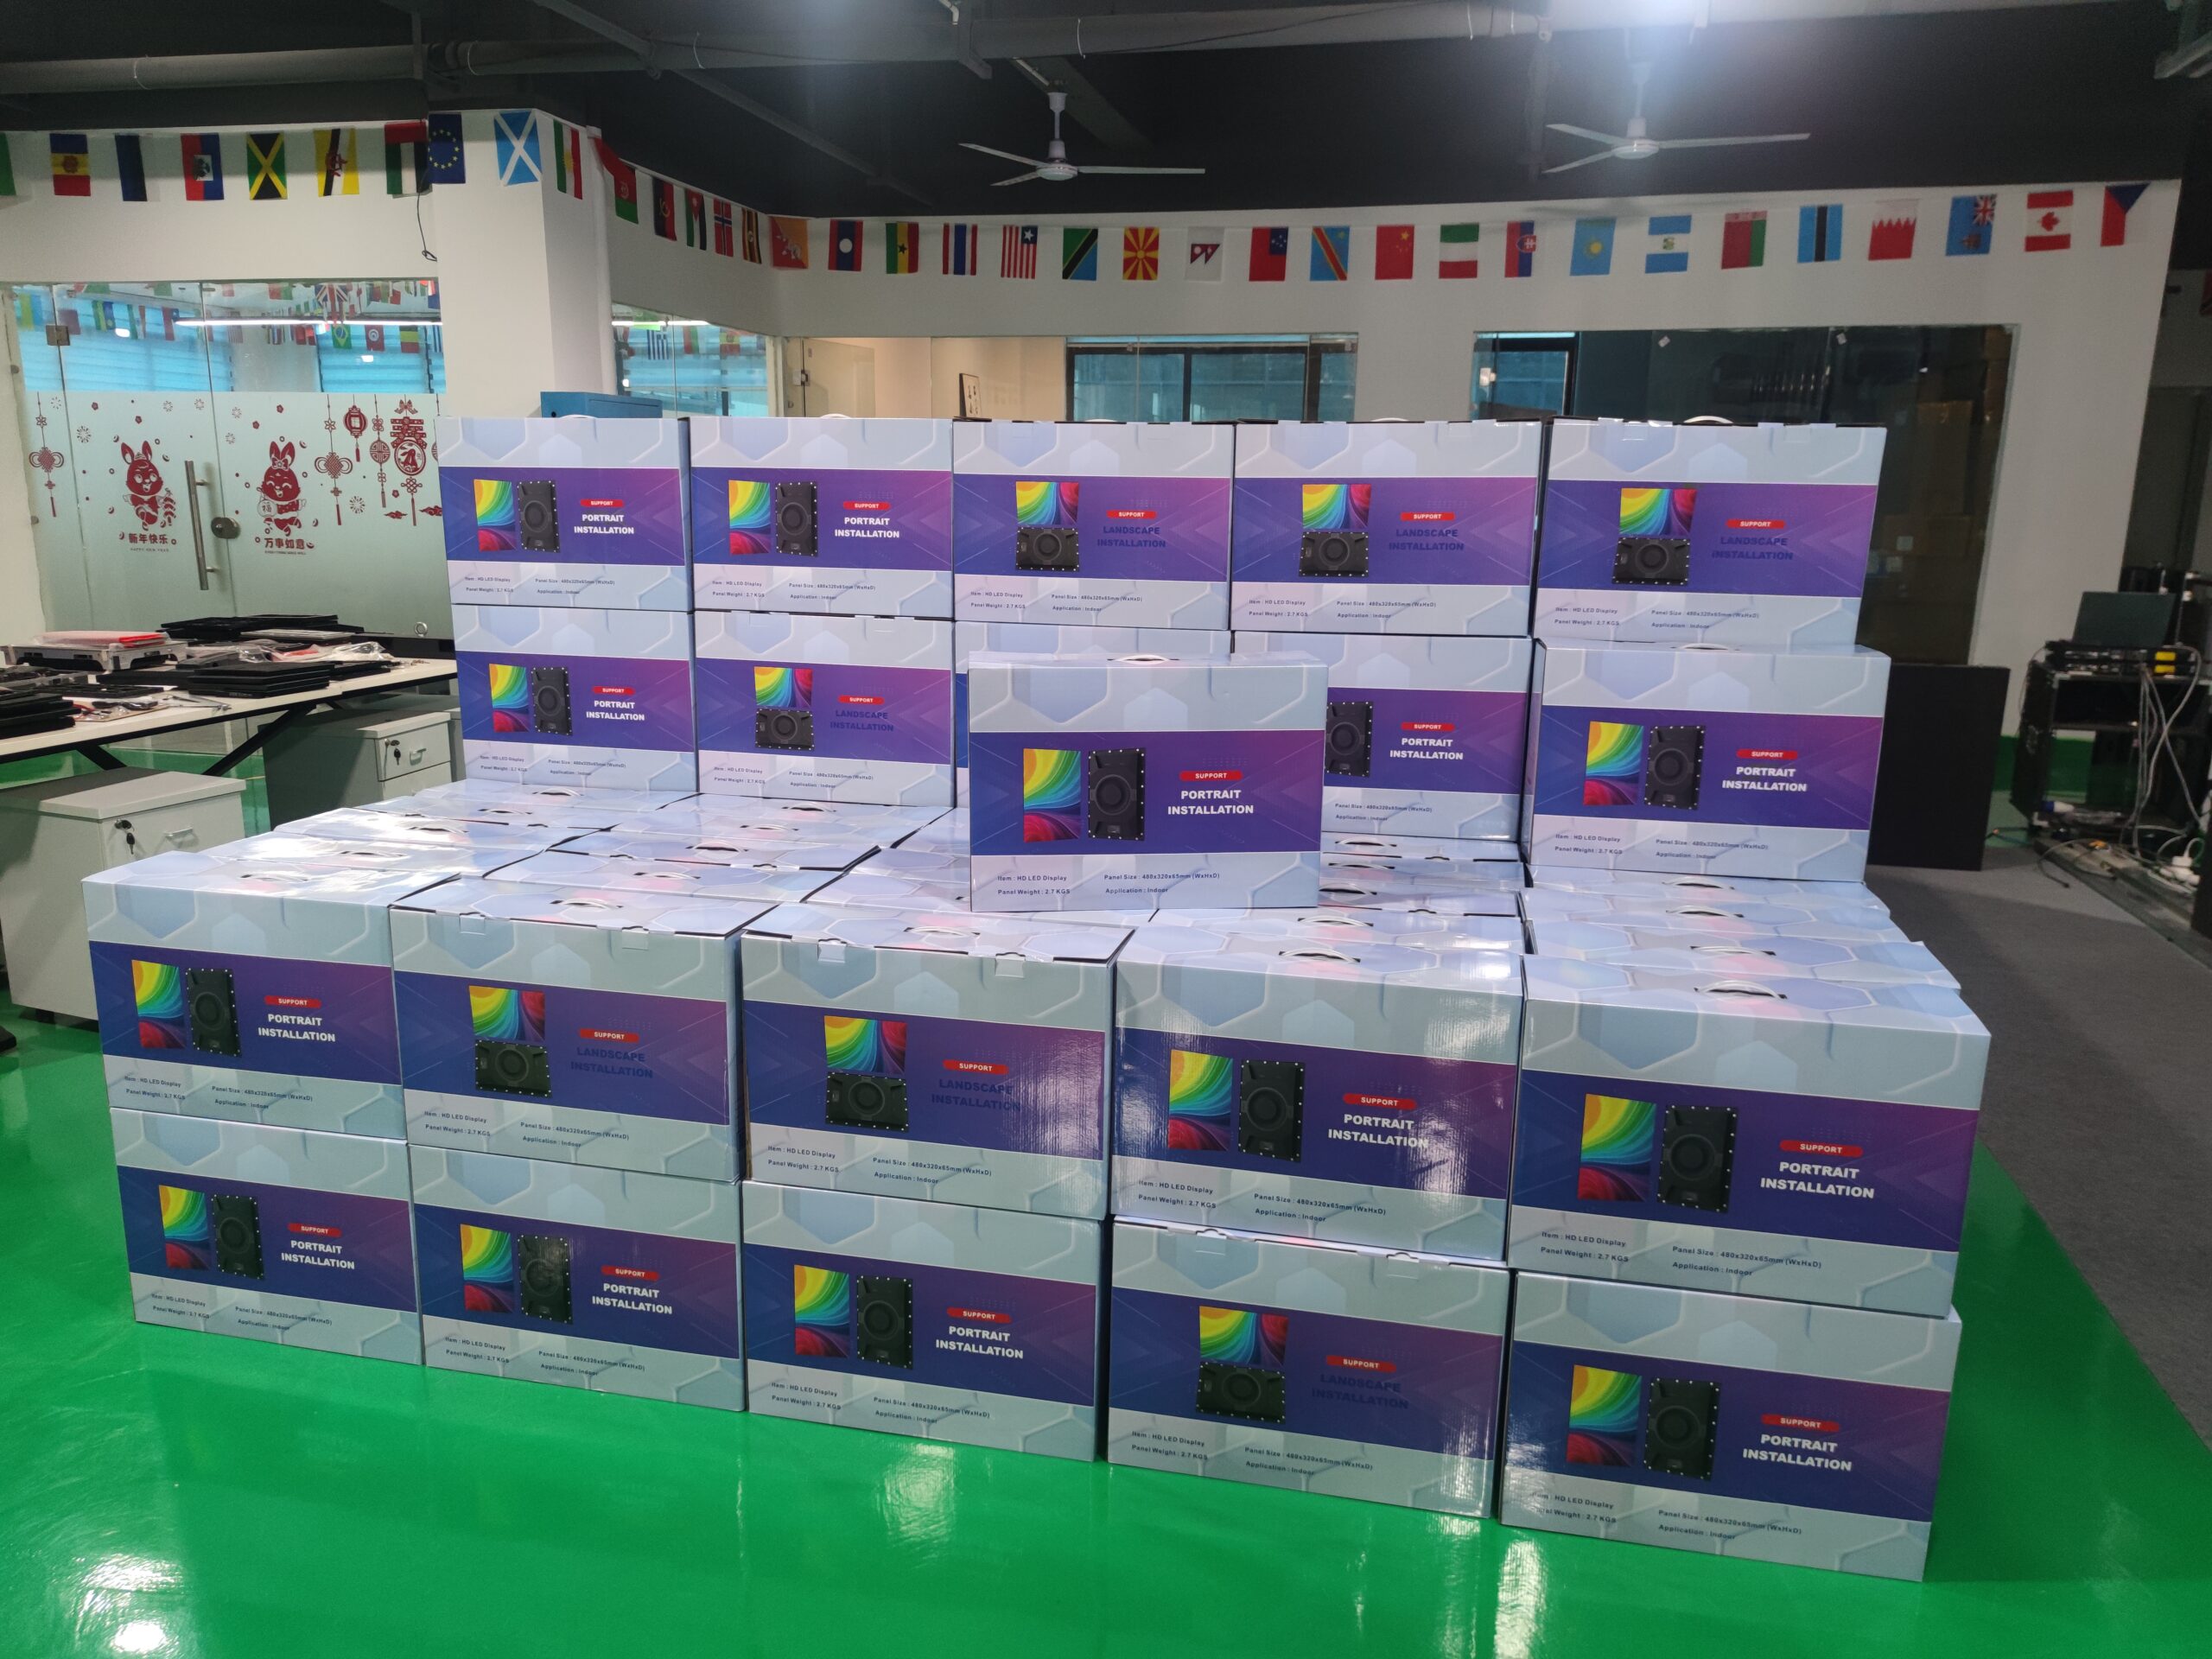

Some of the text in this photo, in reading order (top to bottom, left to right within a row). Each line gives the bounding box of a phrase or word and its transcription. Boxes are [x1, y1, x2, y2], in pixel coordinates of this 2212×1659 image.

[844, 517, 890, 525] PORTRAIT
[574, 525, 634, 534] INSTALLATION
[835, 529, 899, 538] INSTALLATION
[1103, 525, 1160, 535] LANDSCAPE
[1395, 529, 1459, 537] LANDSCAPE
[129, 533, 168, 544] 新年快乐
[1096, 538, 1166, 548] INSTALLATION
[1719, 536, 1788, 546] LANDSCAPE
[1711, 550, 1793, 561] INSTALLATION
[594, 700, 635, 709] PORTRAIT
[586, 711, 645, 721] INSTALLATION
[835, 709, 888, 720] LANDSCAPE
[830, 721, 893, 732] INSTALLATION
[1401, 737, 1452, 747] PORTRAIT
[1389, 750, 1463, 760] INSTALLATION
[1735, 766, 1796, 777] PORTRAIT
[1721, 779, 1808, 791] INSTALLATION
[1180, 789, 1242, 799] PORTRAIT
[1167, 804, 1254, 815] INSTALLATION
[277, 997, 307, 1006] SUPPORT
[268, 1013, 322, 1027] PORTRAIT
[257, 1027, 335, 1042] INSTALLATION
[593, 1031, 625, 1040] SUPPORT
[575, 1046, 646, 1063] LANDSCAPE
[569, 1061, 653, 1078] INSTALLATION
[958, 1062, 993, 1071] SUPPORT
[938, 1077, 1014, 1095] LANDSCAPE
[931, 1093, 1021, 1112] INSTALLATION
[1360, 1096, 1398, 1106] SUPPORT
[1343, 1113, 1414, 1130] PORTRAIT
[1327, 1128, 1428, 1149] INSTALLATION
[1799, 1143, 1842, 1154] SUPPORT
[811, 1150, 836, 1159] Display
[787, 1161, 810, 1170] Weight
[1778, 1161, 1859, 1179] PORTRAIT
[874, 1171, 912, 1181] Application
[1186, 1185, 1213, 1195] Display
[1760, 1177, 1875, 1198] INSTALLATION
[1138, 1193, 1158, 1202] Panel
[1159, 1196, 1184, 1206] Weight
[1254, 1192, 1274, 1201] Panel
[1353, 1205, 1386, 1215] (WxHxD)
[1255, 1208, 1325, 1222] Application Indoor
[300, 1225, 328, 1234] SUPPORT
[290, 1239, 342, 1255] PORTRAIT
[1596, 1237, 1626, 1248] Display
[1540, 1246, 1562, 1255] Panel
[1563, 1249, 1592, 1259] Weight
[1611, 1254, 1629, 1262] KGS
[1672, 1245, 1695, 1254] Panel
[1697, 1248, 1714, 1256] Size
[1784, 1257, 1822, 1268] (WxHxD)
[281, 1252, 355, 1270] INSTALLATION
[614, 1268, 645, 1277] SUPPORT
[1672, 1261, 1753, 1276] Application Indoor
[603, 1282, 659, 1299] PORTRAIT
[592, 1295, 672, 1314] INSTALLATION
[962, 1310, 995, 1320] SUPPORT
[948, 1325, 1010, 1342] PORTRAIT
[935, 1338, 1024, 1359] INSTALLATION
[1343, 1358, 1379, 1369] SUPPORT
[1779, 1417, 1821, 1428] SUPPORT
[1760, 1433, 1838, 1452] PORTRAIT
[1742, 1448, 1853, 1471] INSTALLATION
